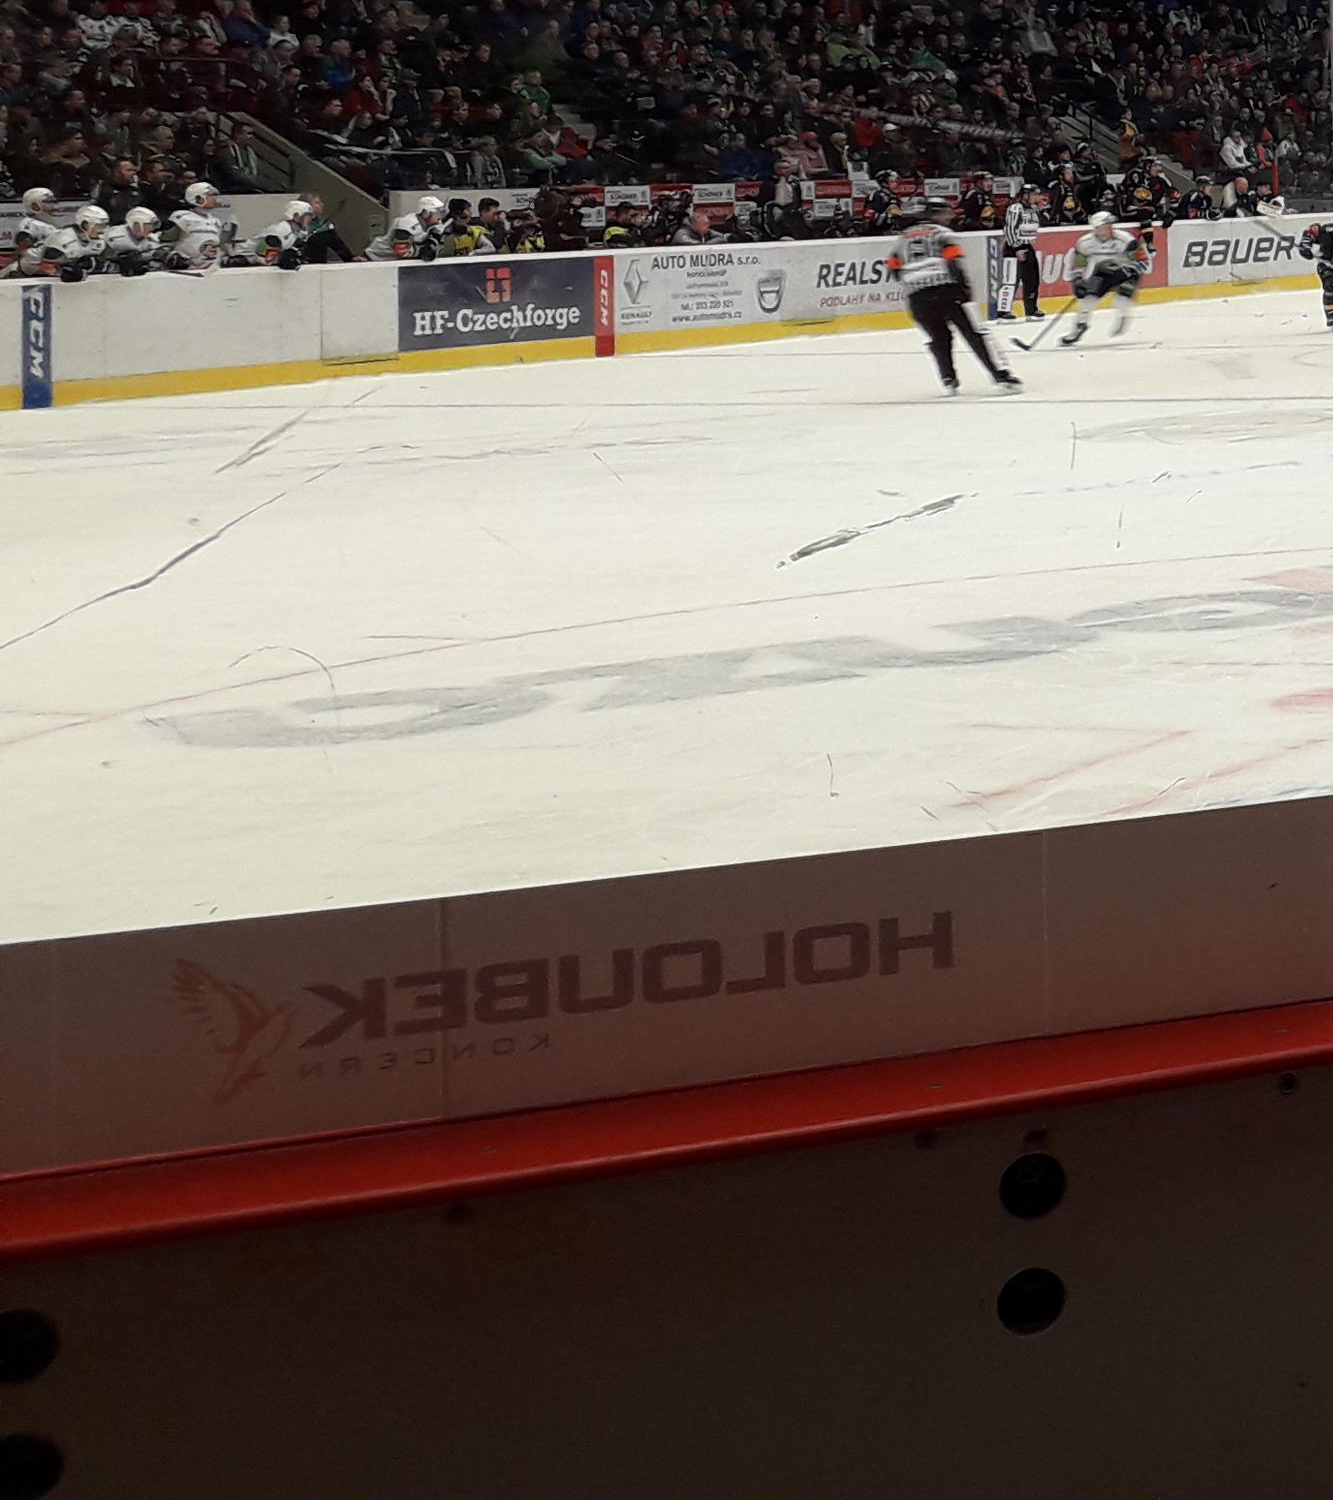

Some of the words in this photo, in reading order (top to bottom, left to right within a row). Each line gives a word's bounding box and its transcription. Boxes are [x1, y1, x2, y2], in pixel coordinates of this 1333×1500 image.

[651, 255, 686, 270] AUTO
[690, 253, 734, 268] MUDRA
[737, 256, 761, 266] s.r.o.
[1182, 235, 1297, 268] BAUER
[412, 303, 581, 337] HF-Czechforge
